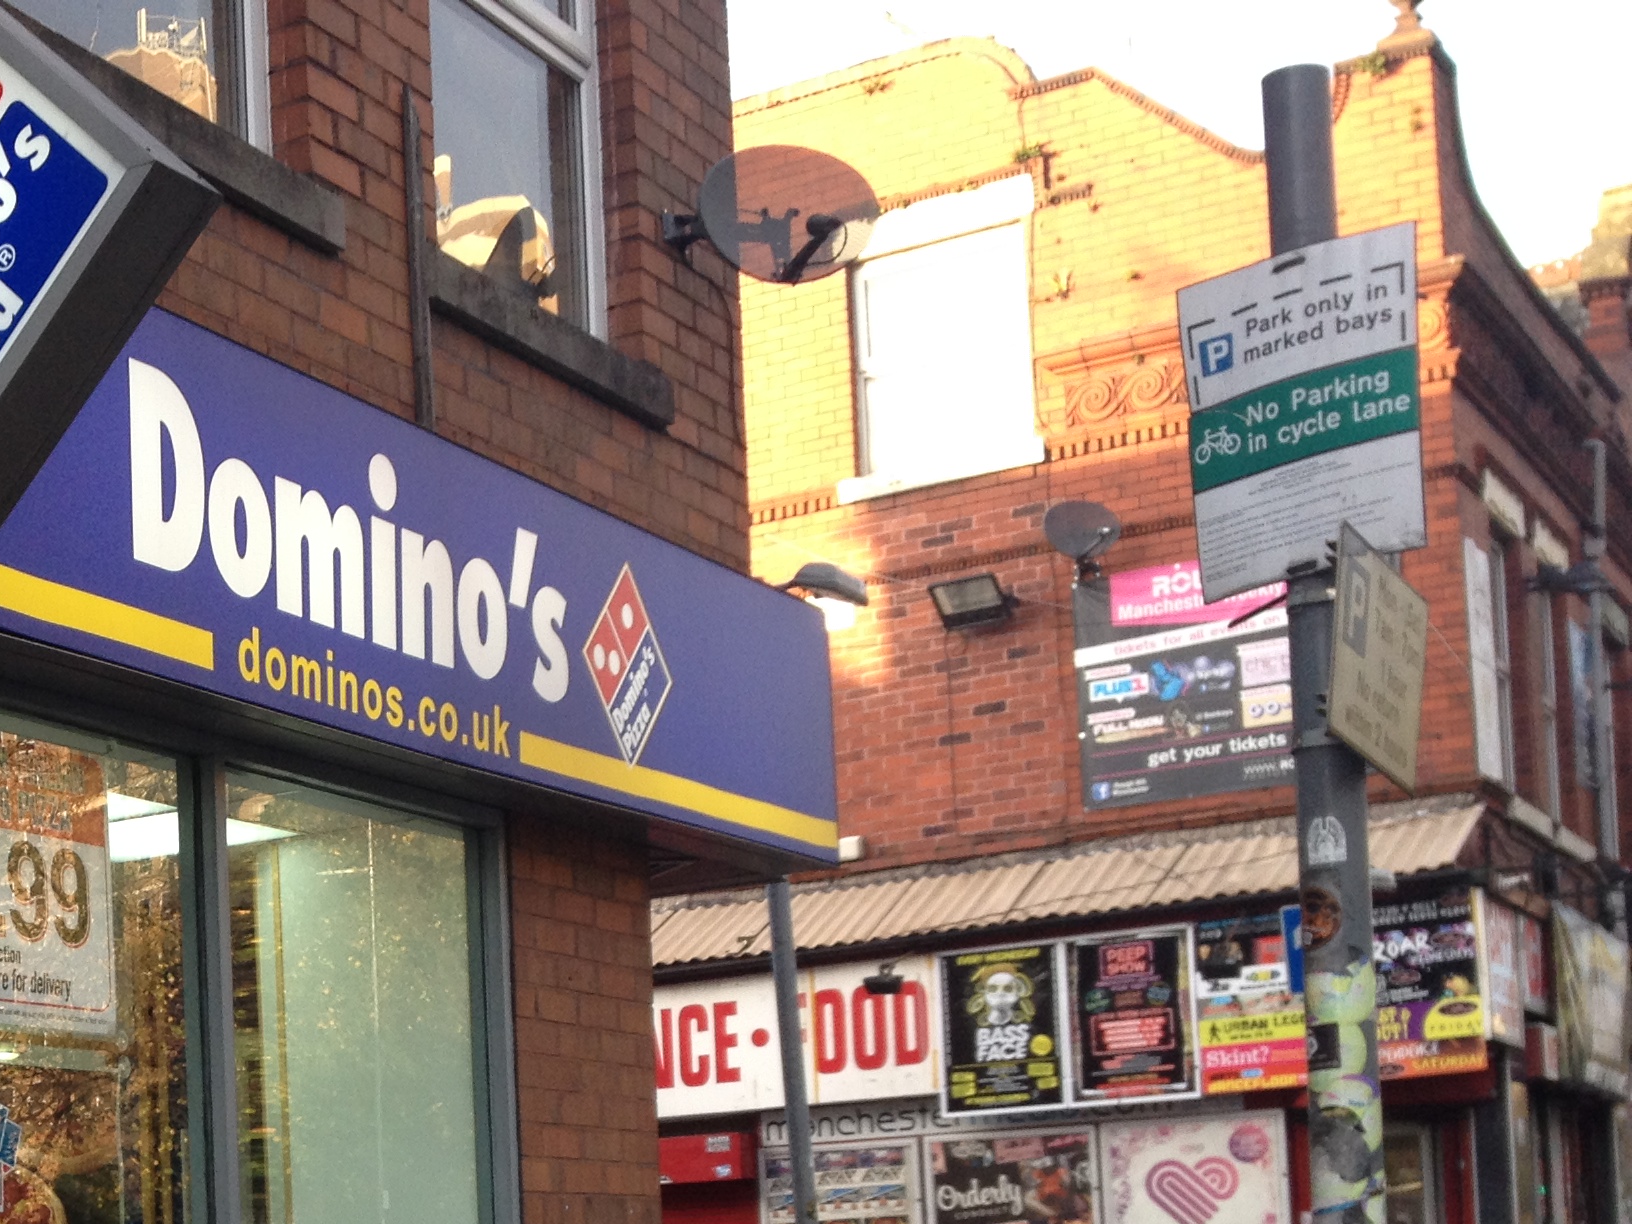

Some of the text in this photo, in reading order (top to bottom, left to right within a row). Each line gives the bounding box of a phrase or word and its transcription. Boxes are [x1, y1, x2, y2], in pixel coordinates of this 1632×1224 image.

[1243, 306, 1393, 364] marked bays
[1245, 282, 1388, 338] Park only in
[1206, 338, 1228, 372] P
[1245, 368, 1391, 428] No Parking
[1247, 393, 1411, 453] in cycle lane
[128, 357, 569, 703] Domino's
[1164, 632, 1182, 646] for
[1190, 630, 1204, 641] all
[1263, 615, 1281, 627] on
[238, 627, 511, 758] dominos.co.uk
[622, 702, 652, 757] Pizza
[1147, 733, 1287, 768] get your tickets
[11, 968, 27, 992] for
[30, 970, 72, 1001] delivery
[797, 981, 930, 1074] OOD
[975, 1023, 1030, 1046] BASS
[975, 1043, 1029, 1063] FACE
[1206, 1044, 1270, 1069] Skint?
